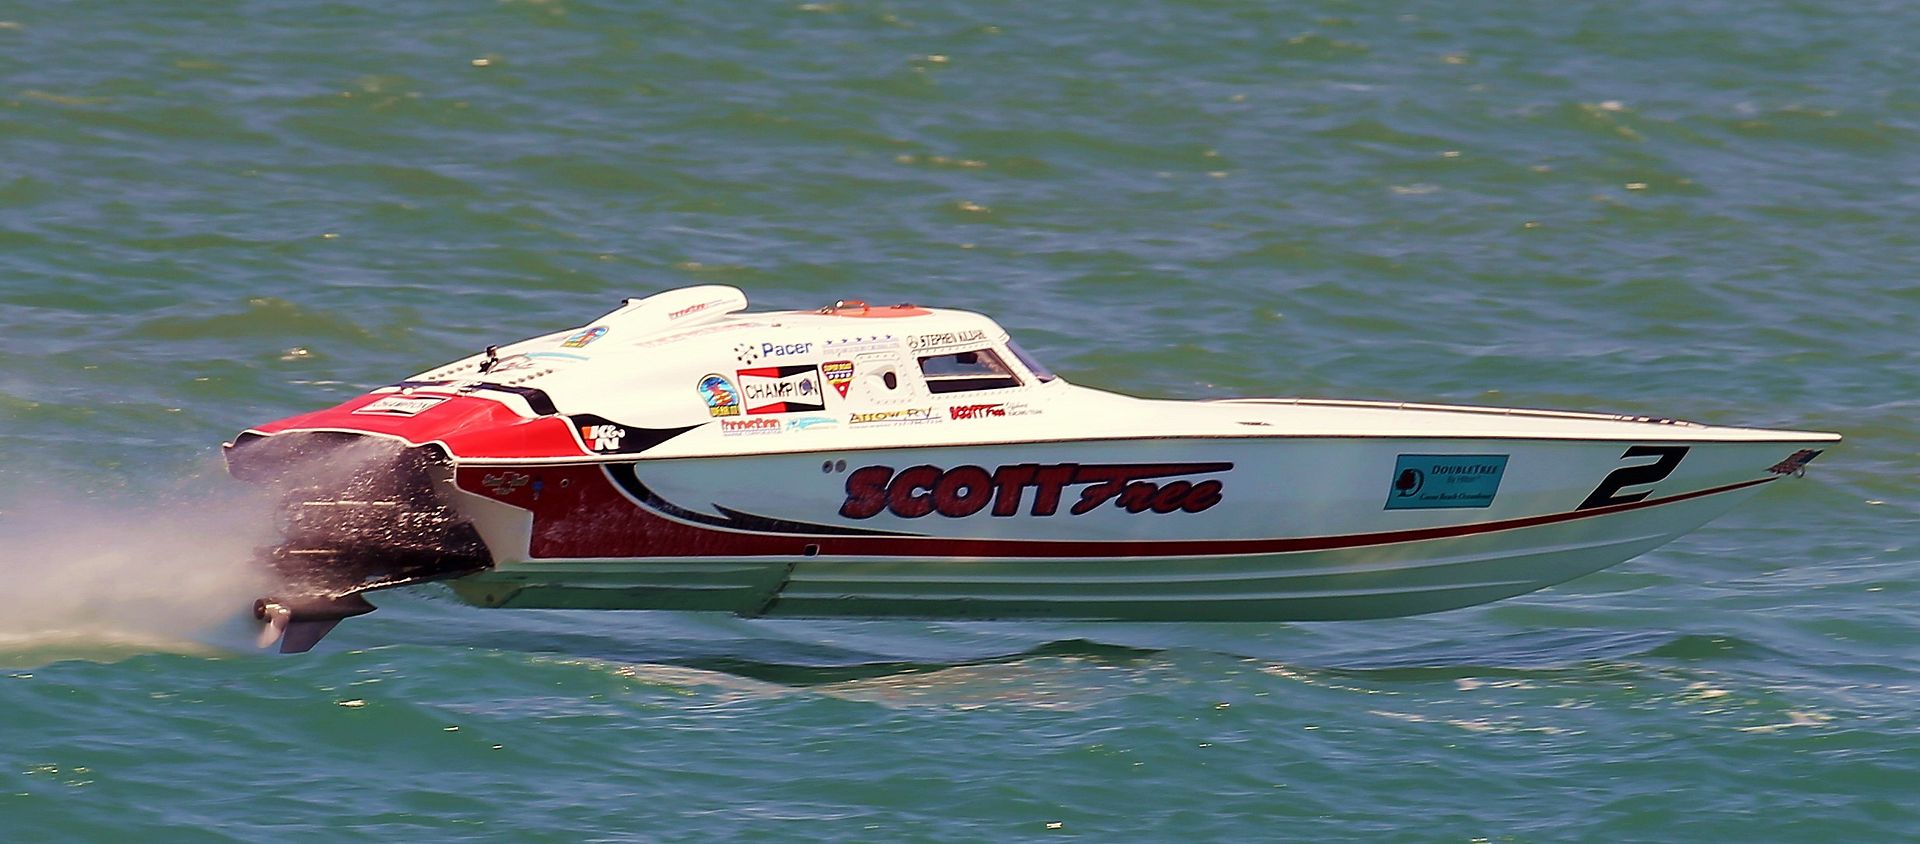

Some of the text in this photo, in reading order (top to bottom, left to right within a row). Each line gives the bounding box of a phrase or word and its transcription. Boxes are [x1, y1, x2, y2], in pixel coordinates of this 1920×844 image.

[762, 342, 813, 358] Pacer
[745, 379, 819, 399] CHAMPION
[838, 463, 1234, 519] SCOTT Free
[1575, 445, 1690, 511] 2
